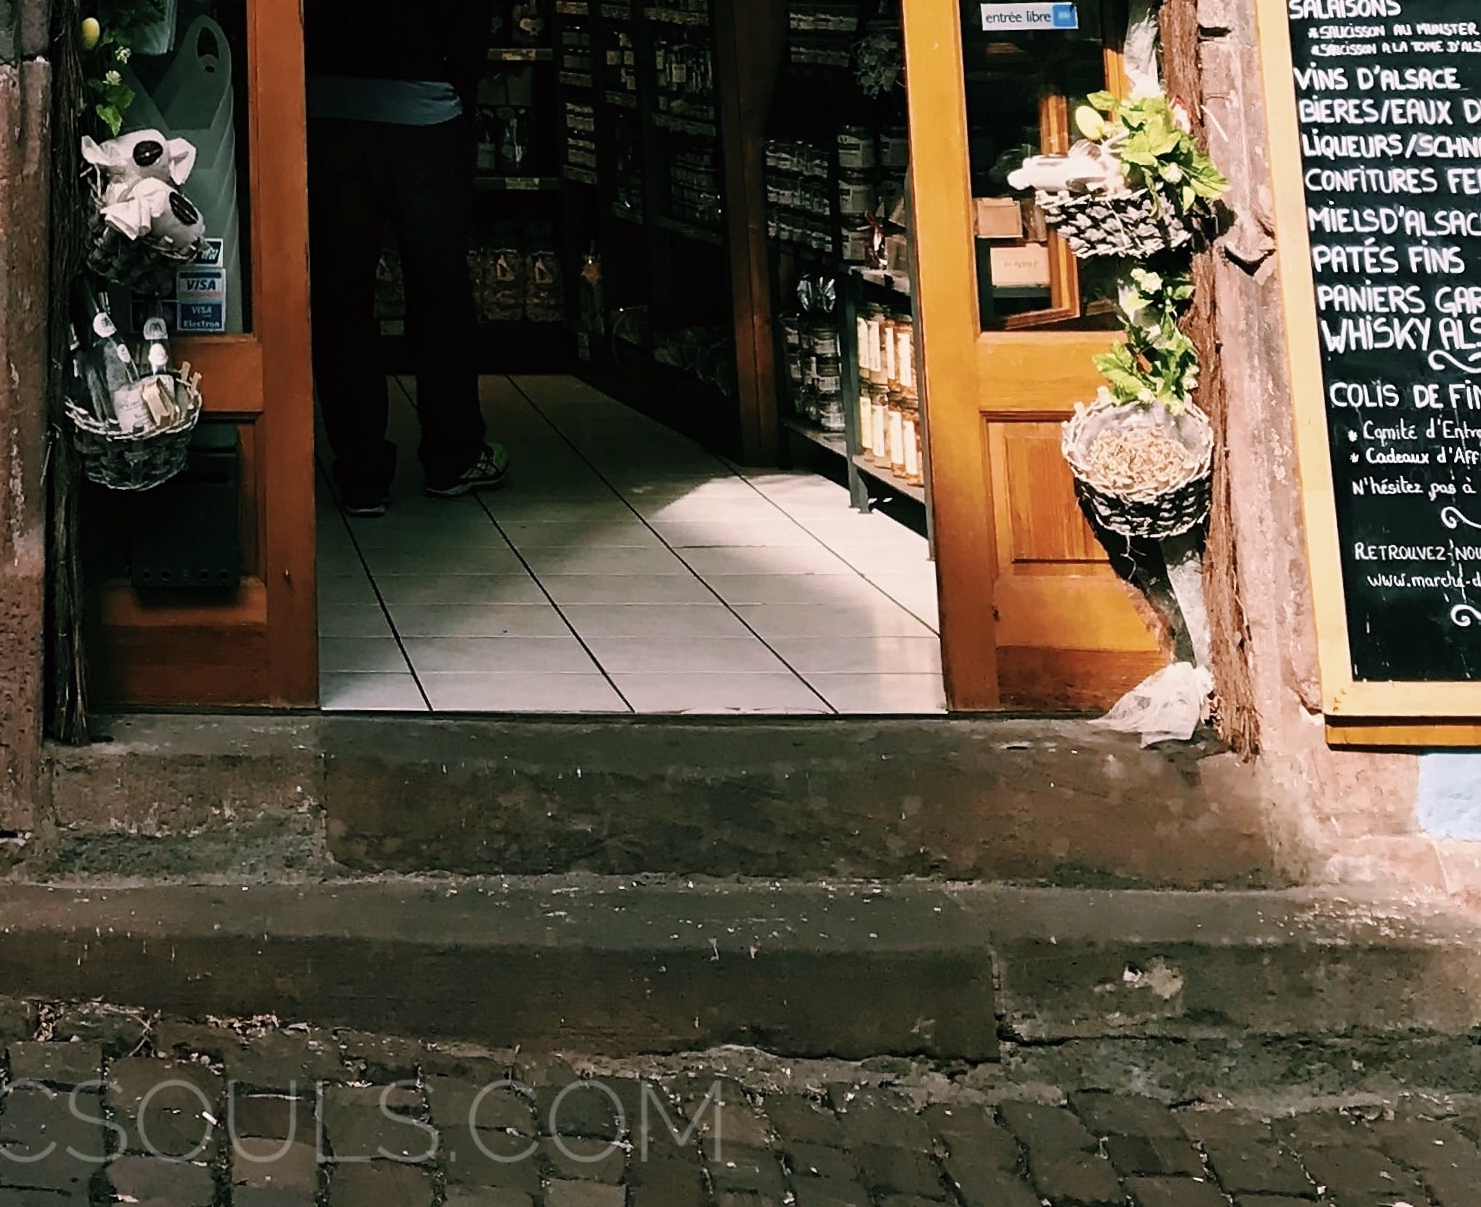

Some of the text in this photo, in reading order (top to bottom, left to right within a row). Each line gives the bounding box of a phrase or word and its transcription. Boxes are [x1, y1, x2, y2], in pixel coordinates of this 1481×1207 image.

[985, 11, 1022, 23] entrée
[1026, 10, 1051, 23] libre
[1319, 22, 1480, 39] SAUCISSON AU MUNSTER
[1293, 61, 1461, 91] VINS D'ALSACE
[1463, 98, 1481, 123] D
[1302, 128, 1481, 160] LIQUEURS/SCHN
[1305, 165, 1481, 194] CONFITURES FE
[1308, 200, 1380, 233] MIELS
[1312, 237, 1465, 274] PATÉS FINS
[186, 279, 216, 291] VISA
[1317, 279, 1426, 314] PANIERS
[192, 305, 212, 314] VISA
[1319, 315, 1431, 354] WHISKY
[1329, 380, 1400, 408] COLIS
[1413, 384, 1443, 409] DE
[1363, 418, 1418, 443] Comité
[1365, 447, 1430, 464] Cadeaux
[1352, 475, 1477, 501] N'hésitez pas à
